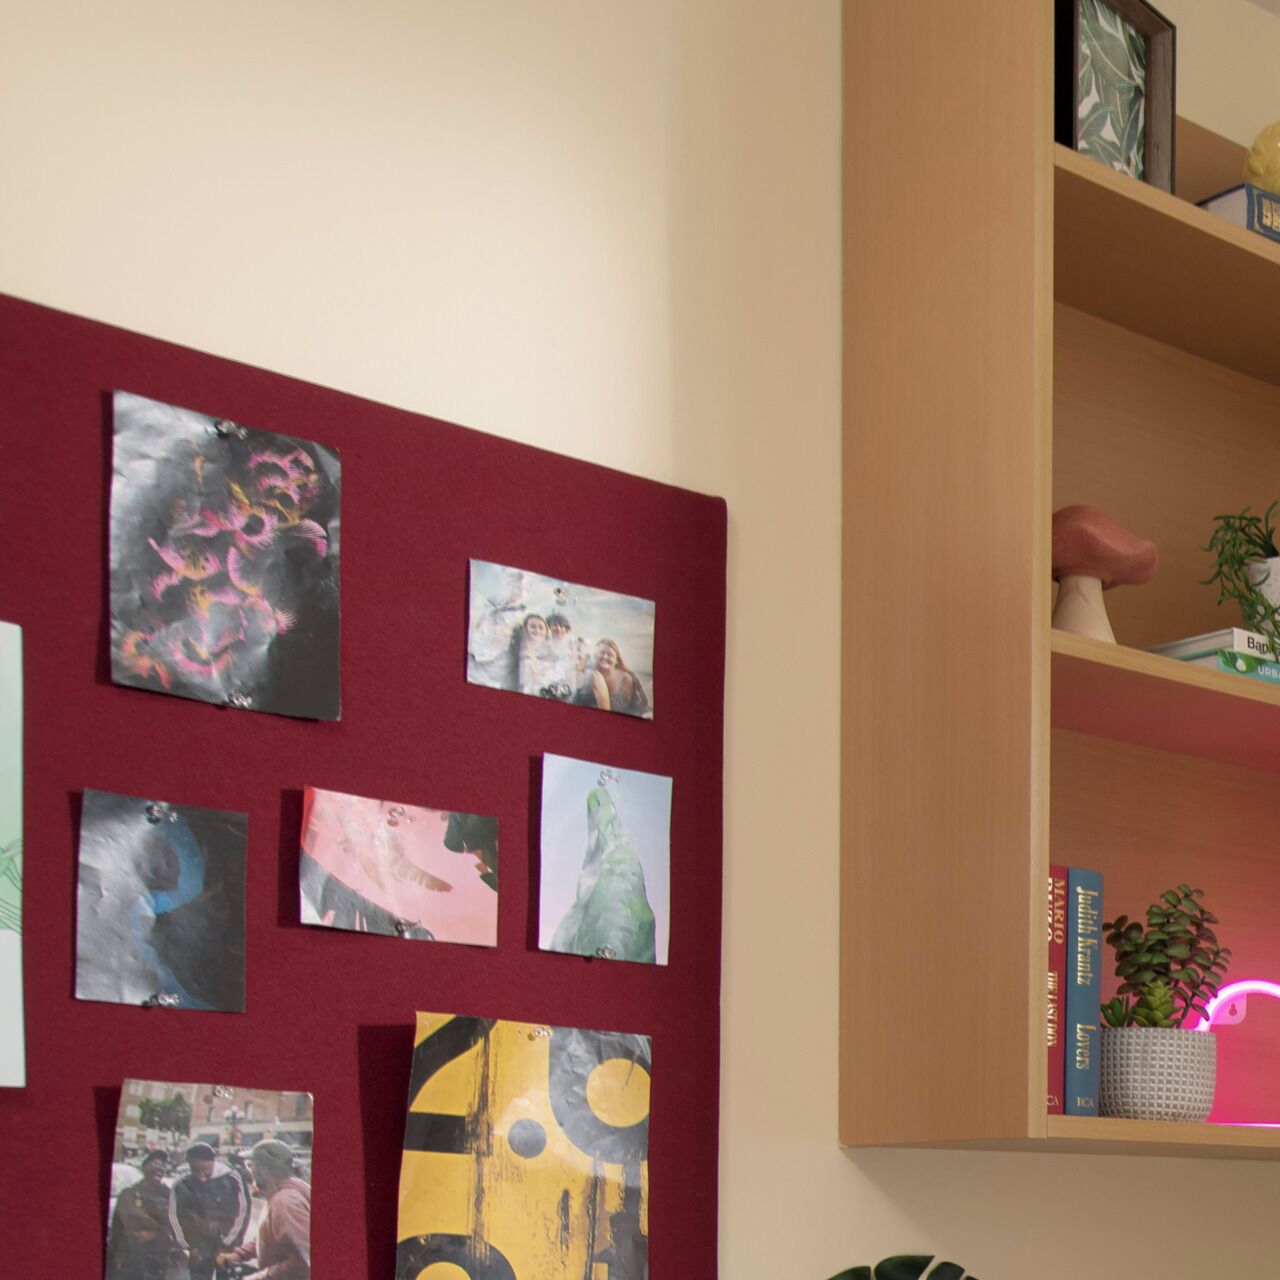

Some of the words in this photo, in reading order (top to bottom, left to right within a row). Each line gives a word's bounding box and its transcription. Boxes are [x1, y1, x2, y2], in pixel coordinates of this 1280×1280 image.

[1053, 878, 1065, 944] MARIO
[1076, 886, 1099, 934] Judith
[1076, 936, 1099, 985] Krantz
[1075, 1023, 1097, 1070] Lovers
